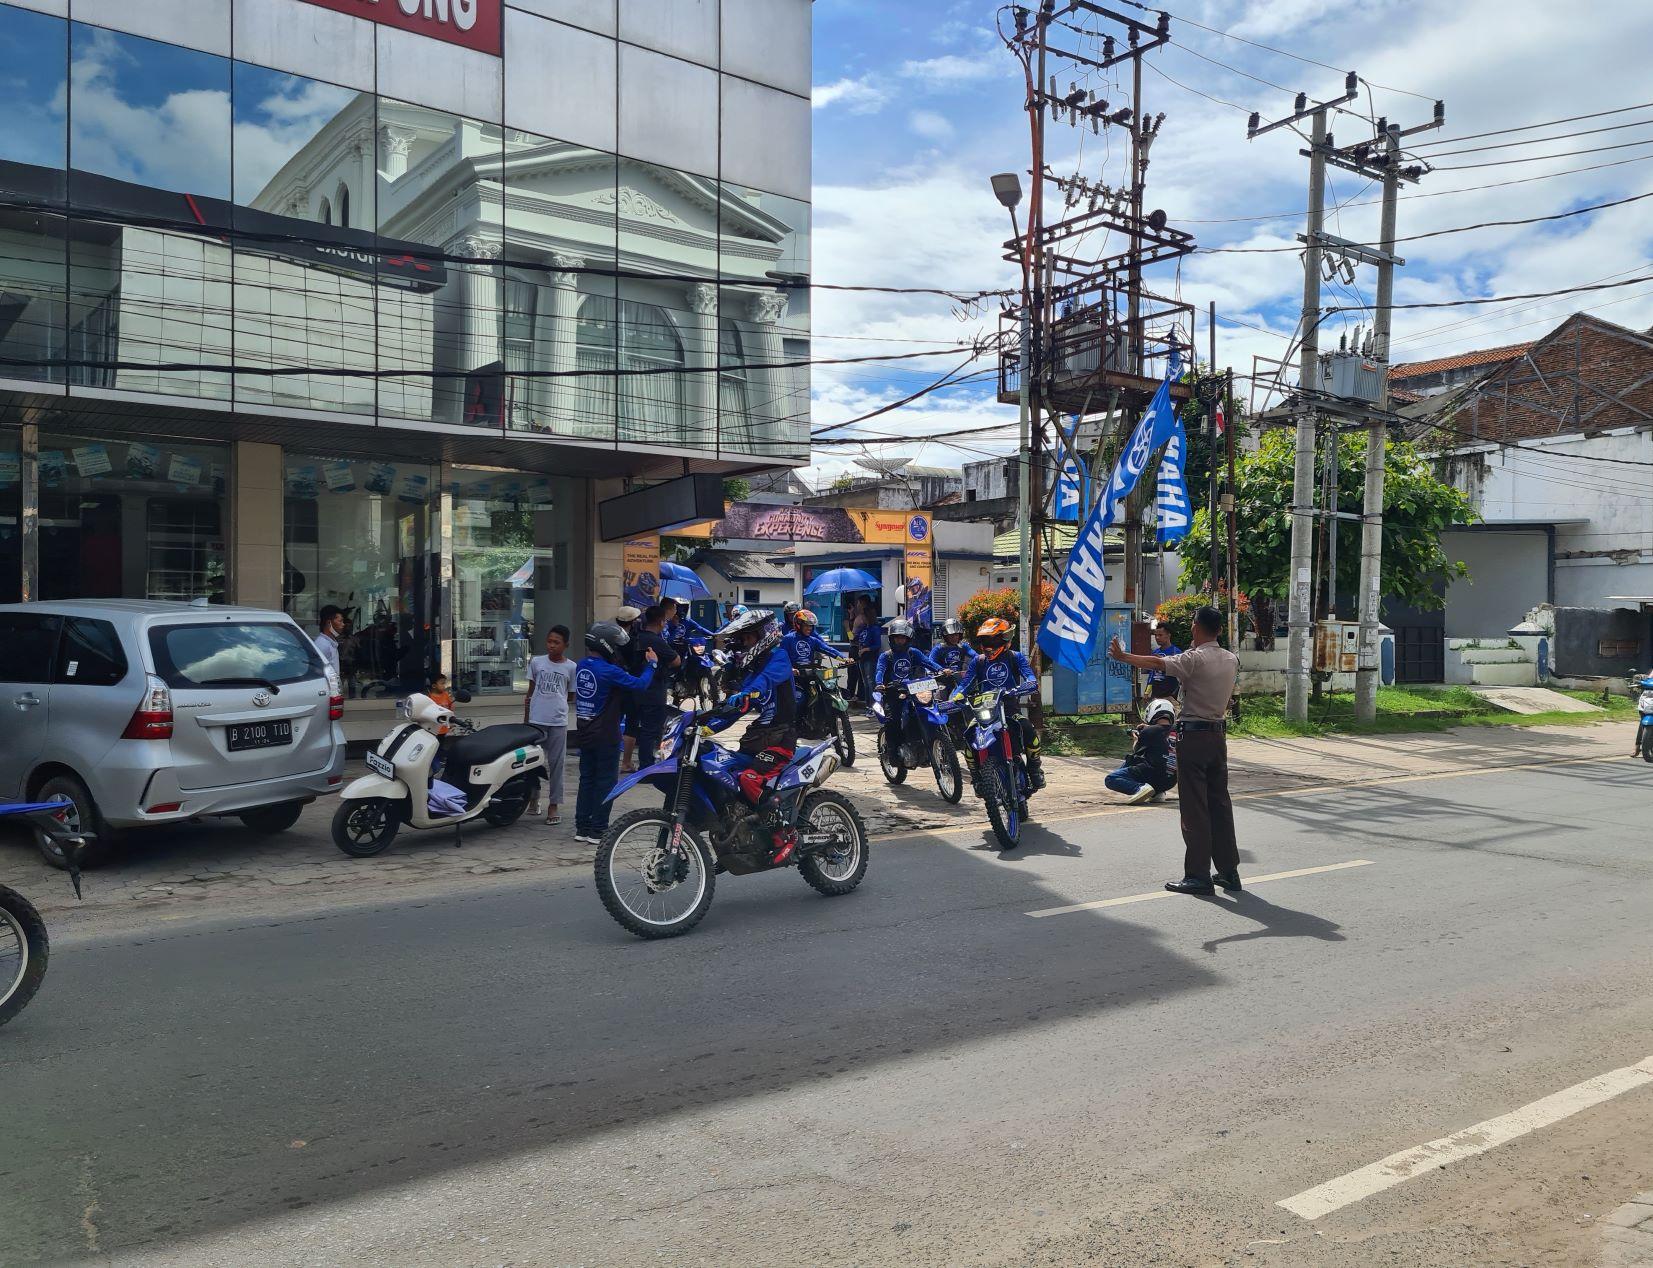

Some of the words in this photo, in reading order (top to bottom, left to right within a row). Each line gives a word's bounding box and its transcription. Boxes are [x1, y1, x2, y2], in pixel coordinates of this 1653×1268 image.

[755, 521, 825, 540] EXPERIENCE
[232, 728, 238, 741] B
[244, 723, 266, 740] 2100
[369, 755, 391, 774] Fazzio
[801, 764, 815, 780] 86
